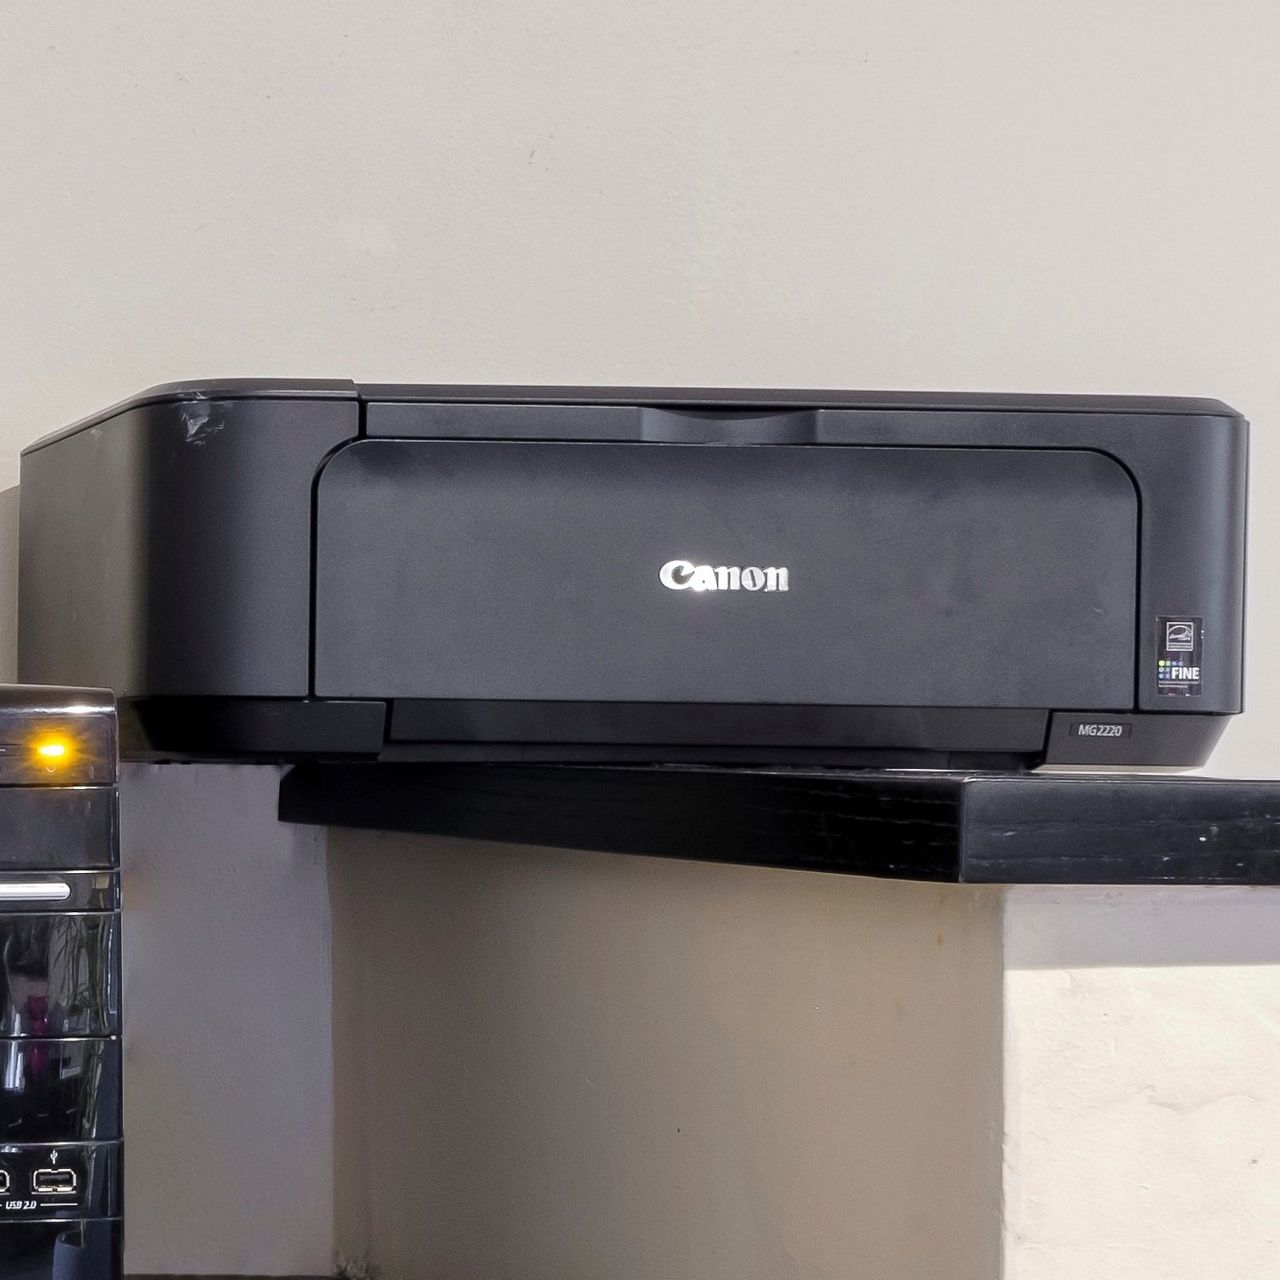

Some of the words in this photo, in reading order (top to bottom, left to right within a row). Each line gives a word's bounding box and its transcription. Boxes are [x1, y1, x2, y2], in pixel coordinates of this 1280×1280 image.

[659, 559, 790, 592] Canon
[1171, 666, 1200, 680] FINE
[1078, 724, 1123, 737] MG2220
[5, 1199, 24, 1211] USB
[24, 1199, 38, 1211] 2.0
